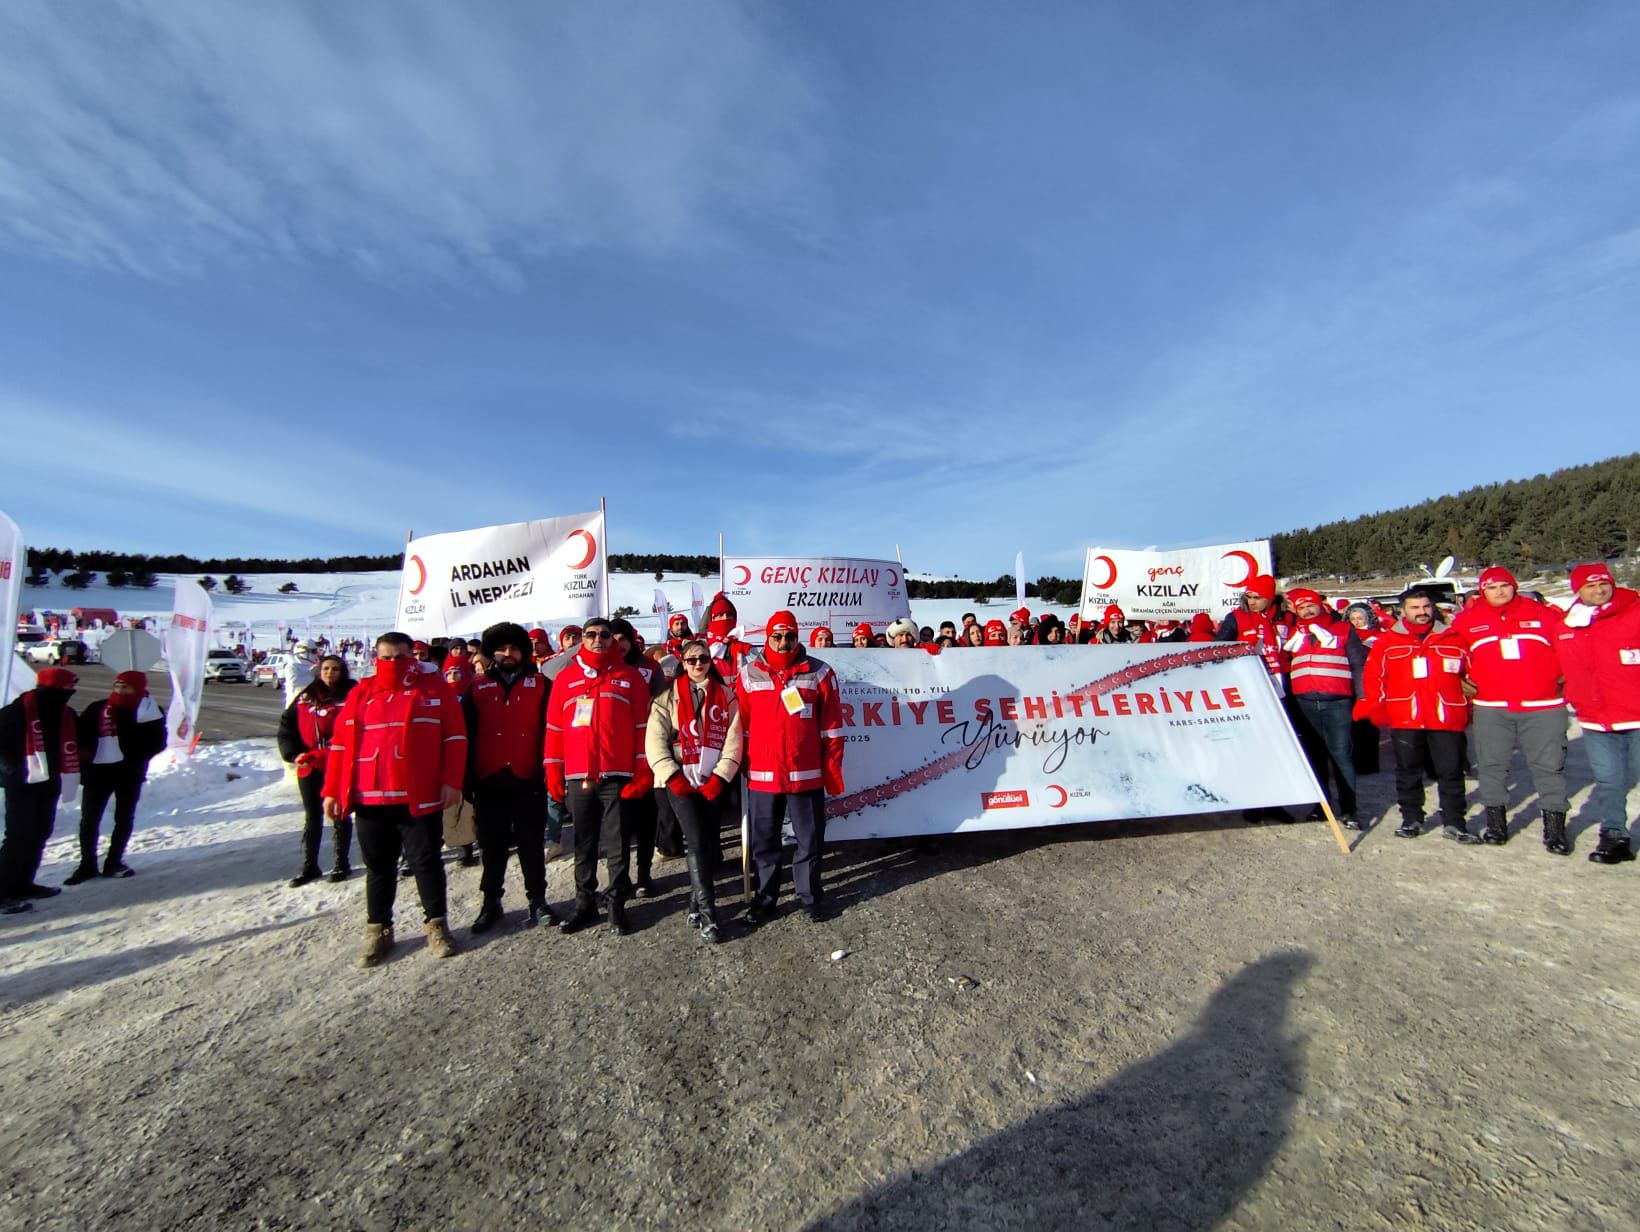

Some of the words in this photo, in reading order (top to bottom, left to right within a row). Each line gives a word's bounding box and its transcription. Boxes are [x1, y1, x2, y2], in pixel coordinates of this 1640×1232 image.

[451, 556, 530, 582] ARDAHAN
[760, 566, 813, 588] GENÇ
[817, 567, 879, 588] KIZILAY
[1148, 565, 1184, 582] genç
[450, 587, 467, 608] İL
[471, 578, 535, 606] MERKEZİ
[563, 580, 598, 591] KIZILAY
[1137, 583, 1199, 597] KIZILAY
[787, 591, 863, 607] ERZURUM
[1088, 597, 1118, 605] KIZILAY
[841, 687, 899, 695] AREKATININ
[840, 696, 956, 727] RKİYE
[974, 687, 1246, 726] ŞEHİTLERİYLE
[845, 735, 871, 743] 2025
[941, 709, 1111, 775] Yürüyor
